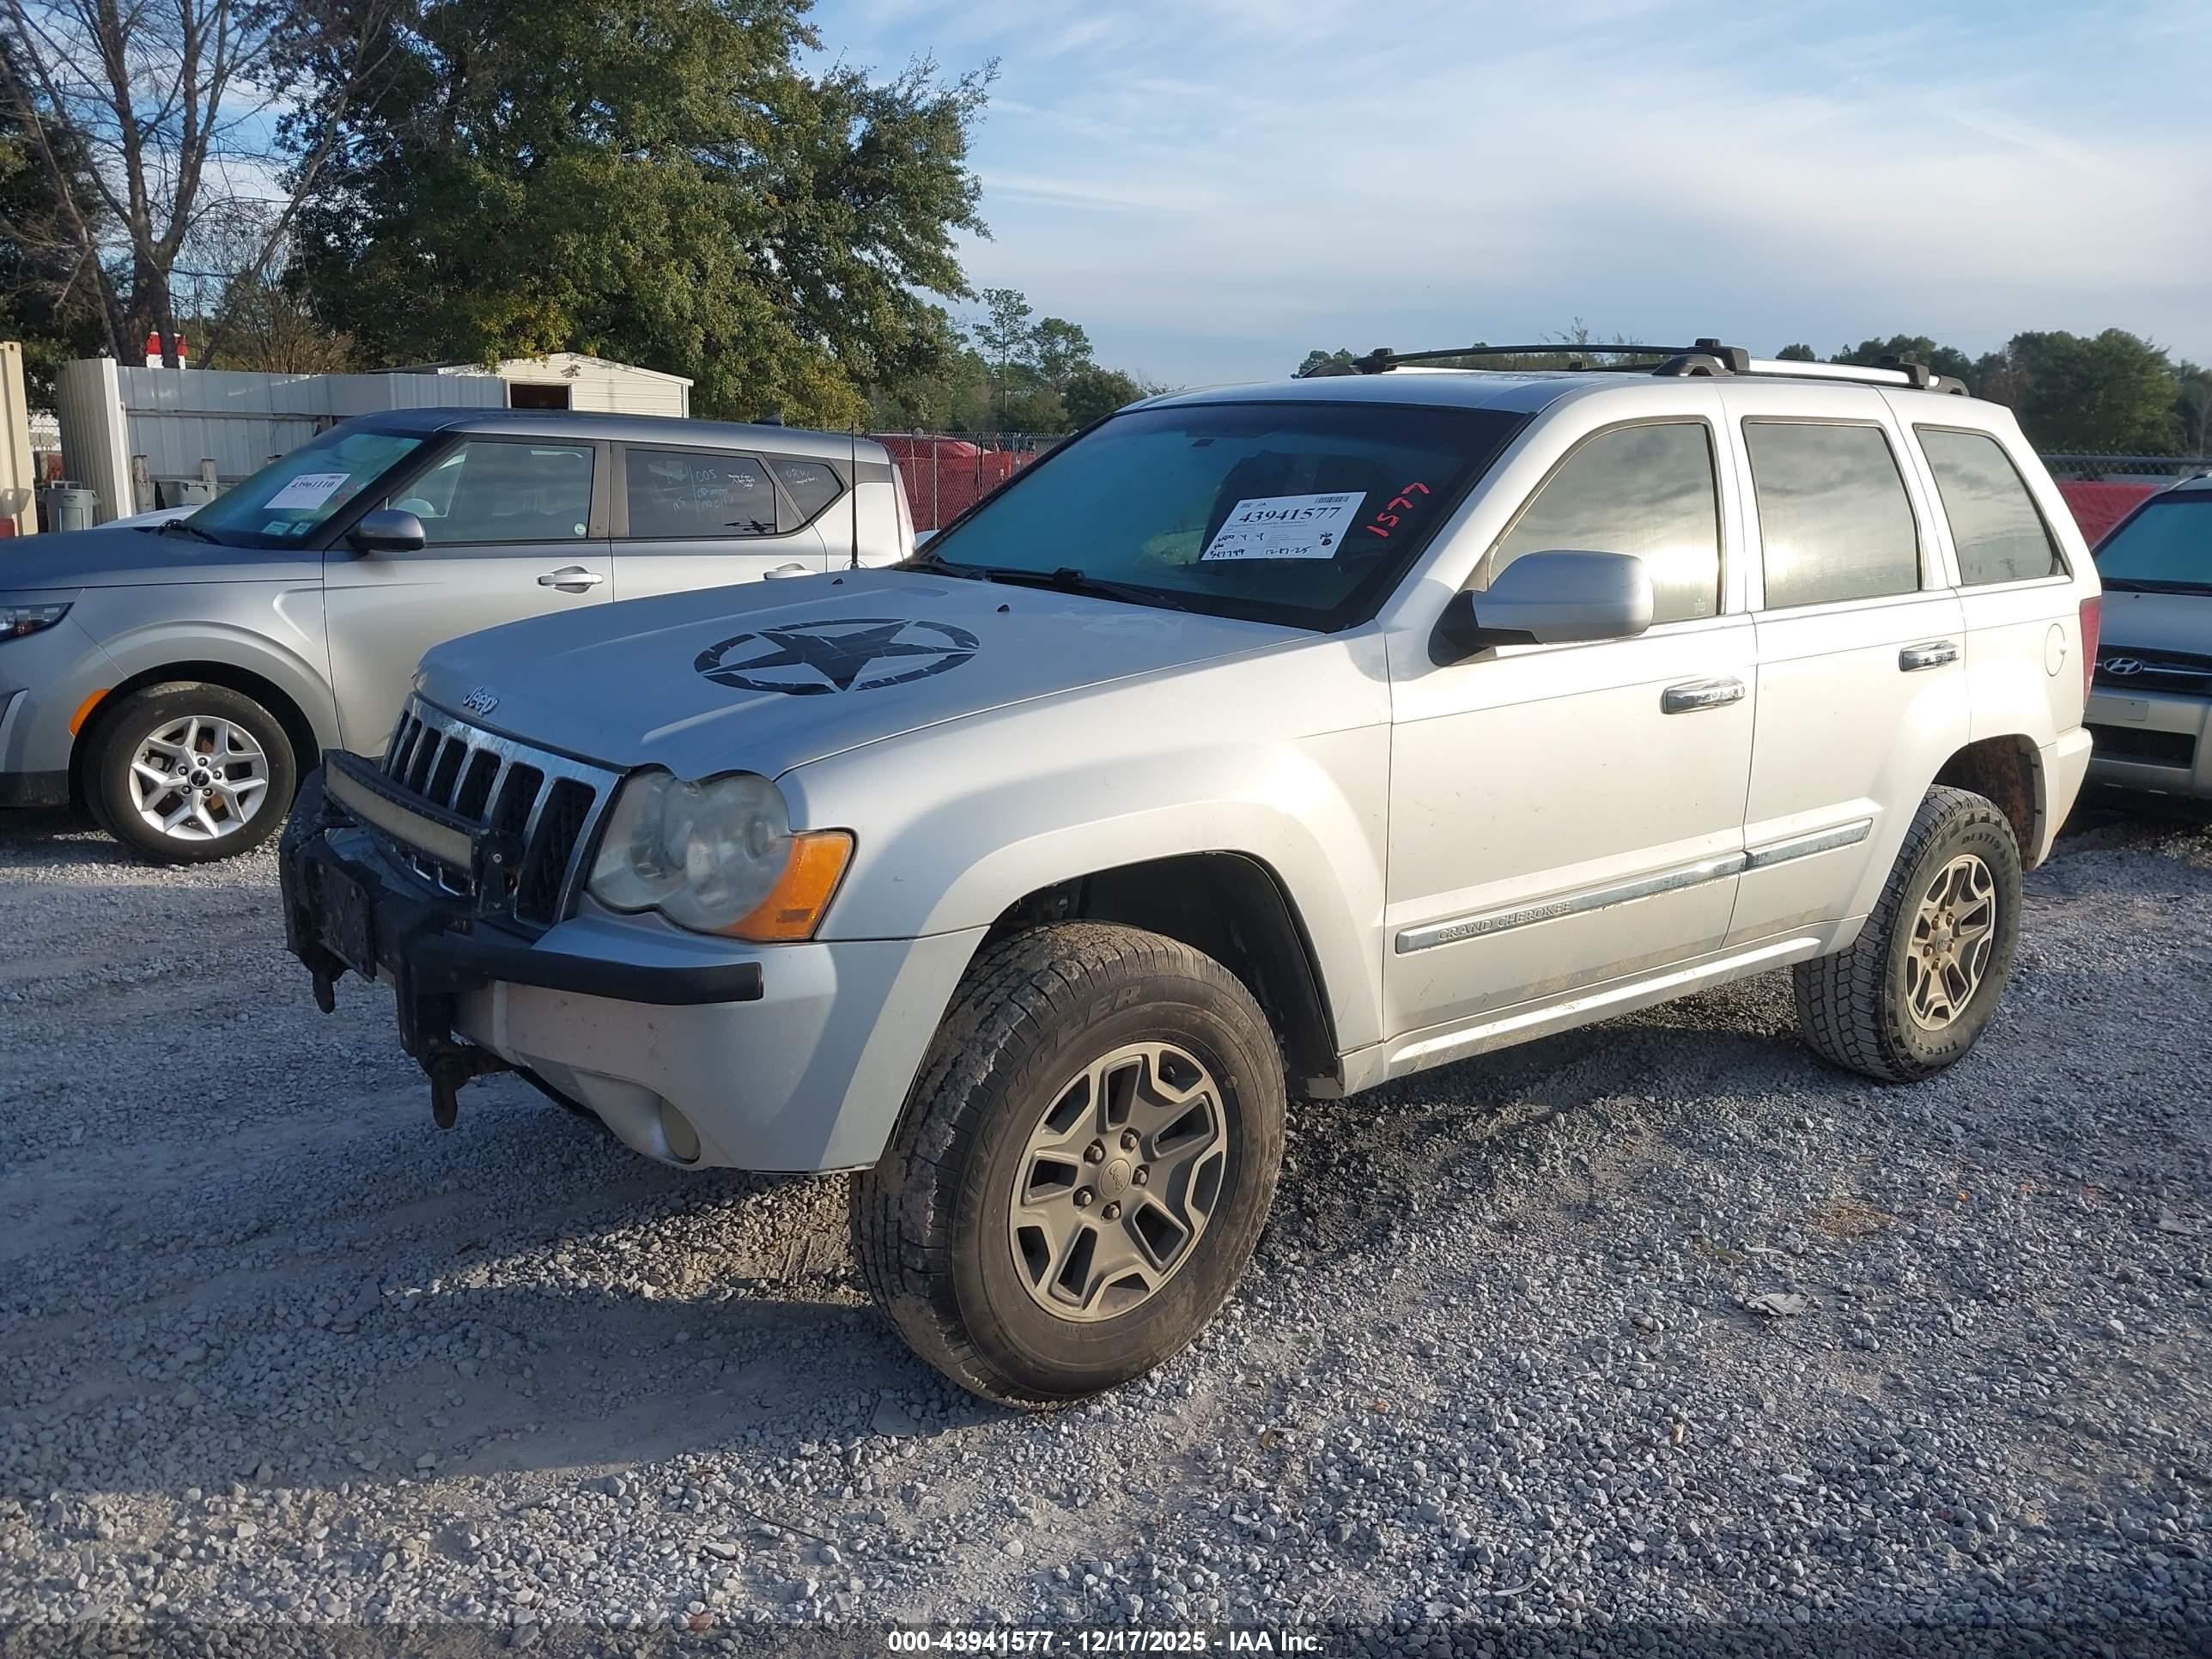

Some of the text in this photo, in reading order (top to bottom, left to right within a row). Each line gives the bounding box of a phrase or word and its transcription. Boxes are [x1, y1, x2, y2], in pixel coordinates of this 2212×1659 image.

[1238, 506, 1342, 523] 43941577
[1366, 482, 1430, 538] 1577
[463, 686, 499, 716] Jeep
[1437, 901, 1572, 942] GRAND CHEROKEE
